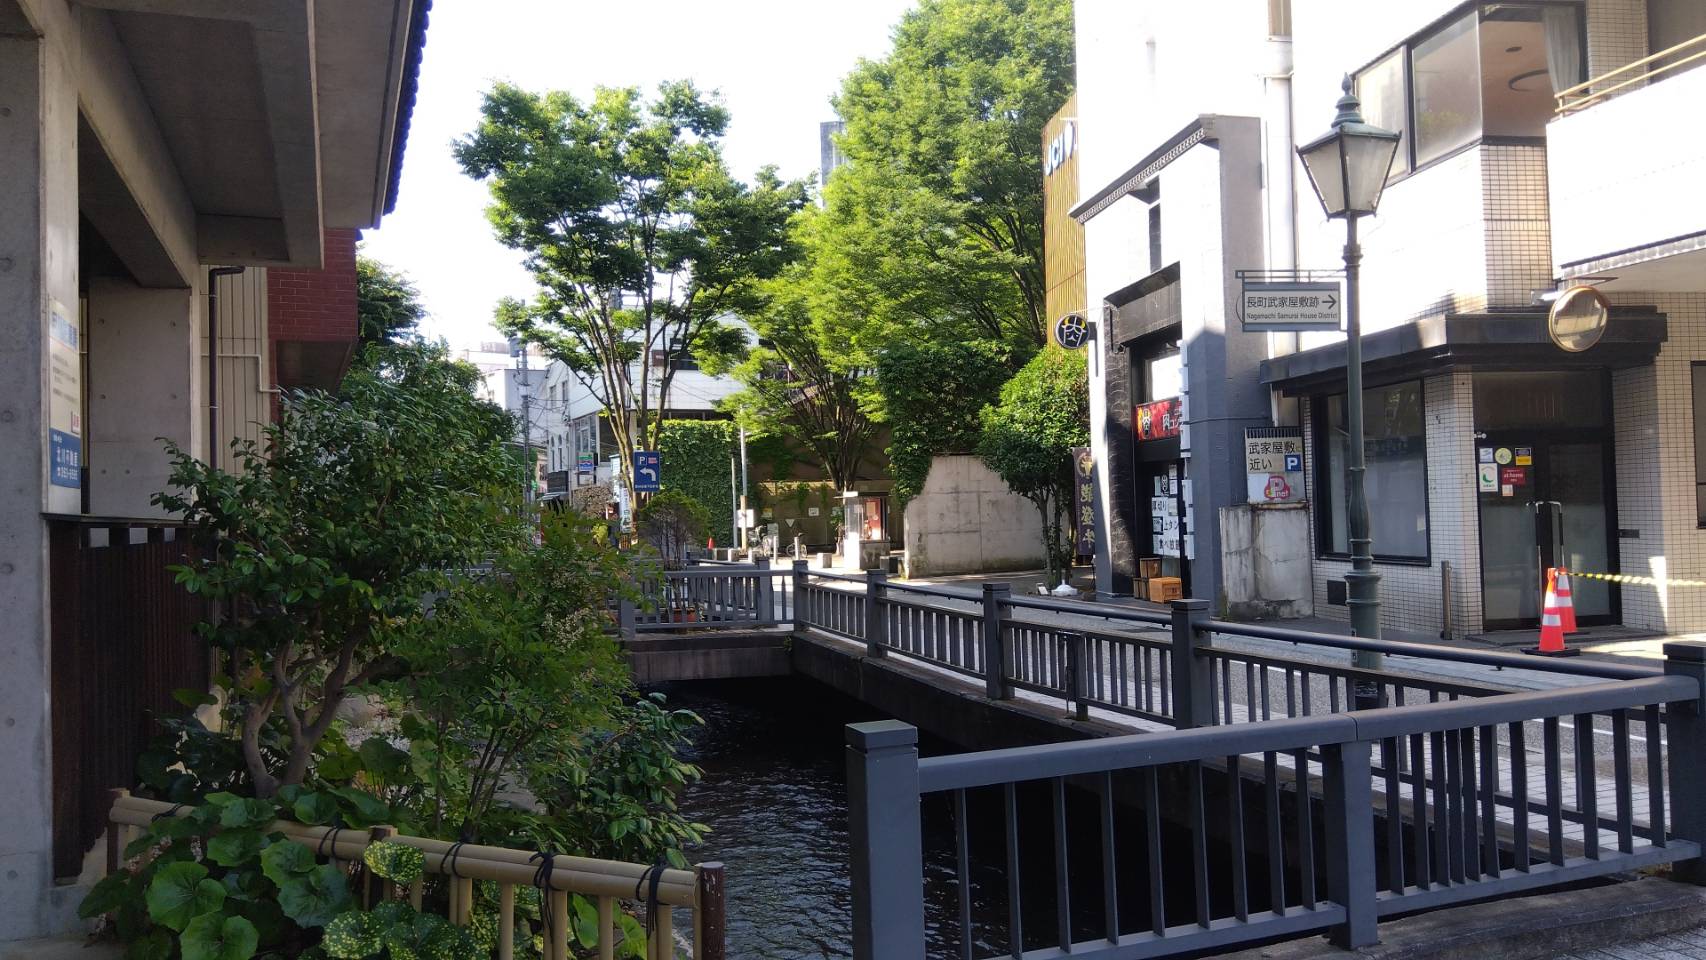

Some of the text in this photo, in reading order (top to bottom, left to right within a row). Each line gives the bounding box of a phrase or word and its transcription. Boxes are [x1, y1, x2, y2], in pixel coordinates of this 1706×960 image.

[1247, 296, 1320, 308] 長町武家屋敷跡
[1246, 312, 1338, 321] Nagamachi Samurai House District
[639, 456, 646, 465] P
[1249, 457, 1298, 471] 近い P
